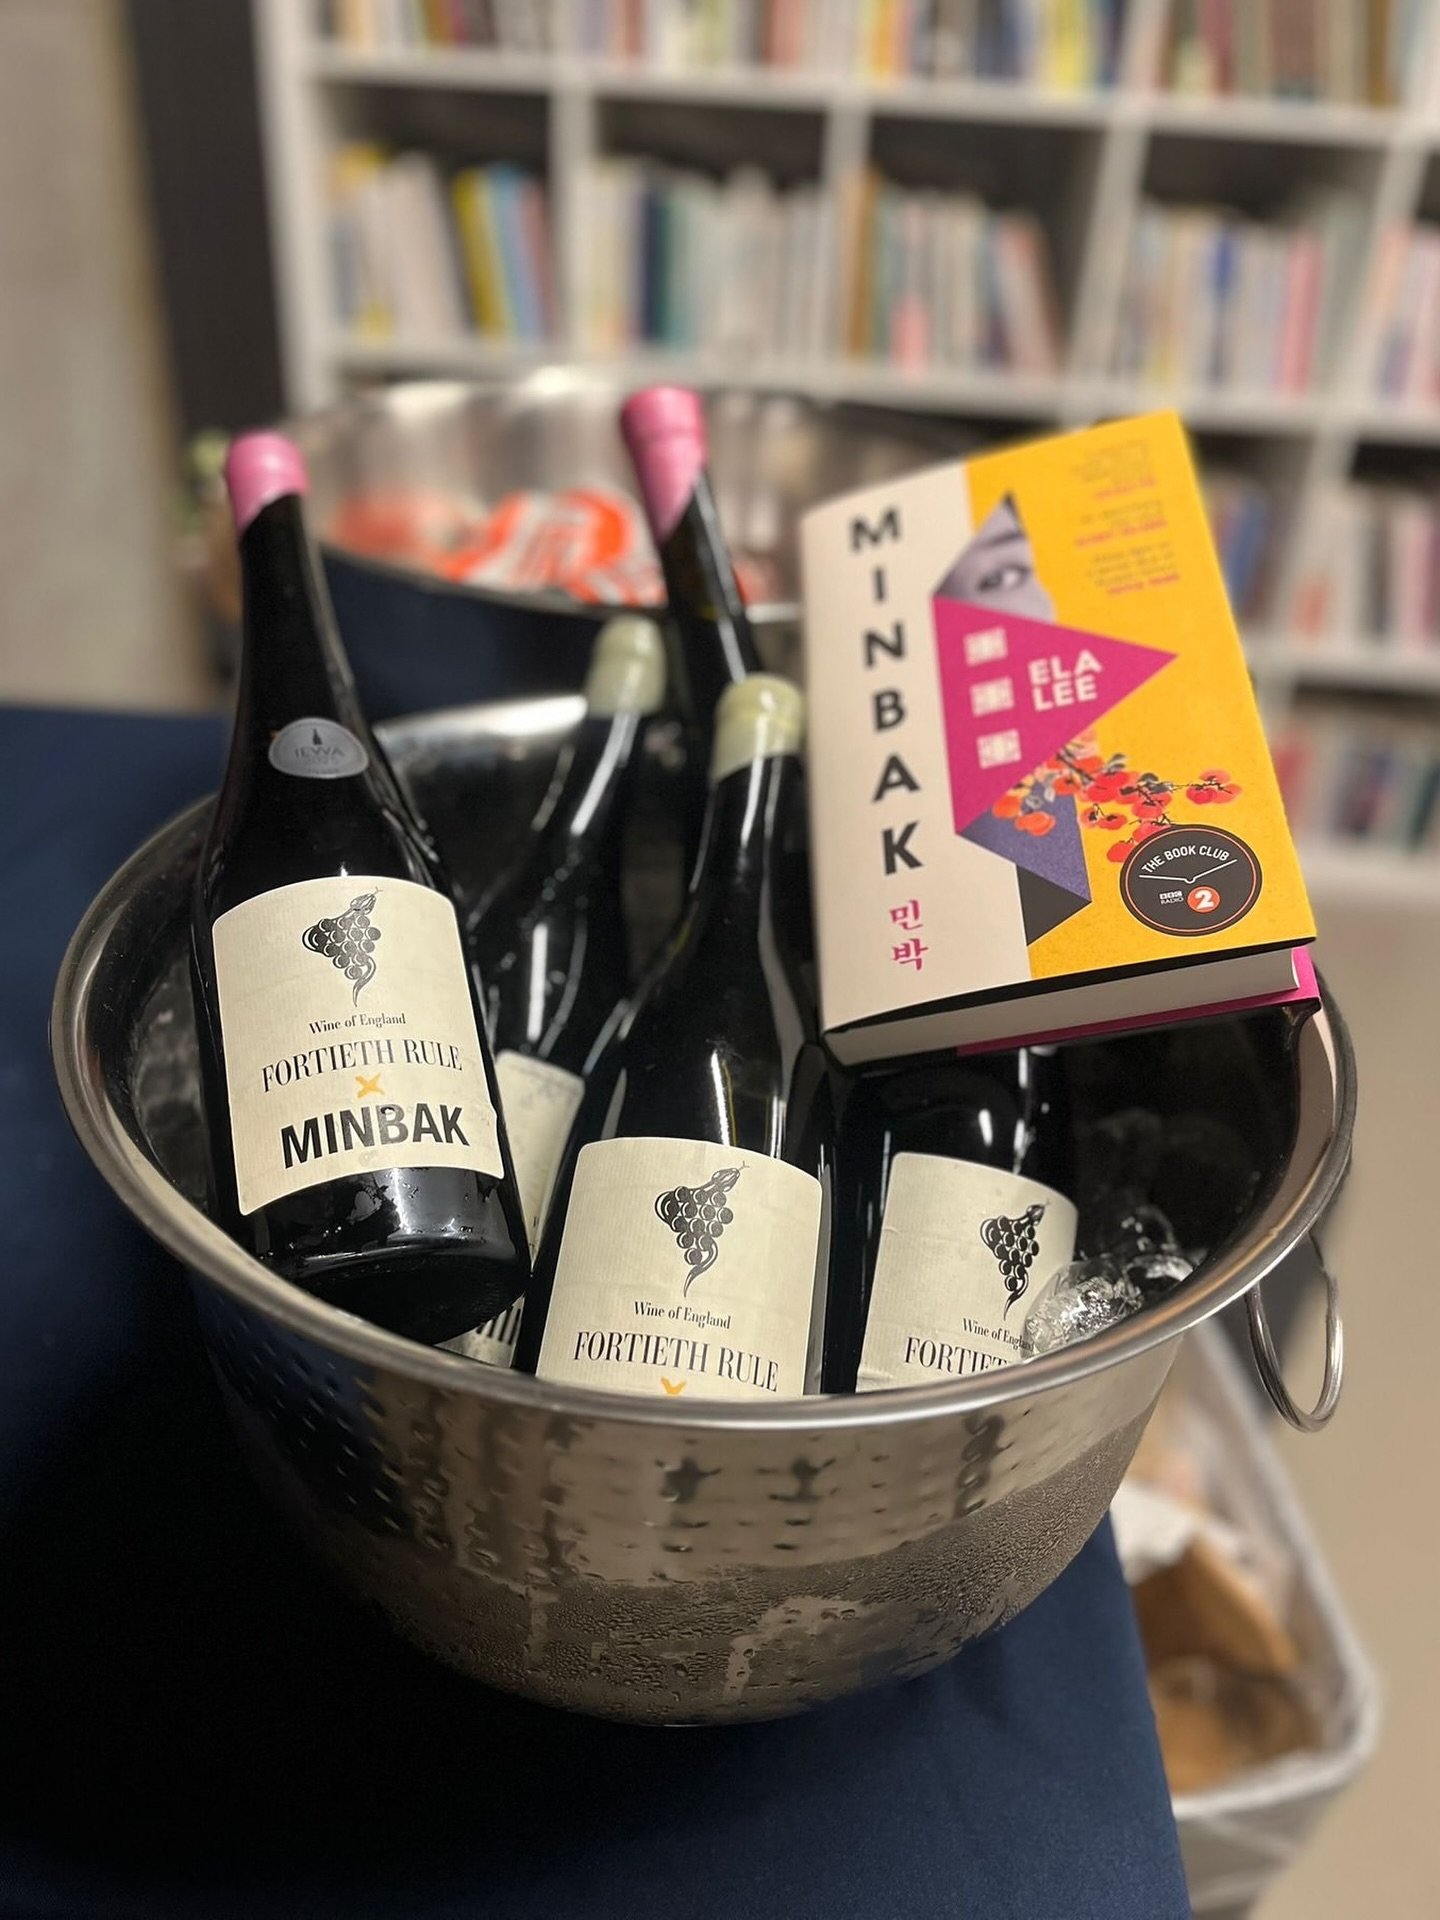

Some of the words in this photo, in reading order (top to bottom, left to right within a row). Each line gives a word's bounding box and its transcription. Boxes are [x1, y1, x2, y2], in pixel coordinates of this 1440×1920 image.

[1028, 650, 1102, 685] ELA
[851, 506, 924, 875] MINBAK
[1033, 674, 1097, 712] LEE
[1141, 856, 1165, 873] THE
[1164, 845, 1196, 861] BOOK
[1199, 845, 1230, 862] CLUB
[1194, 889, 1214, 910] 2
[309, 1019, 341, 1034] Wine
[344, 1014, 358, 1027] of
[359, 1013, 406, 1028] England
[262, 1039, 395, 1093] FORTIETH
[403, 1039, 463, 1071] RULE
[280, 1103, 470, 1169] MINBAK
[634, 1301, 665, 1317] Wine
[667, 1306, 682, 1320] of
[684, 1307, 732, 1329] England
[963, 1318, 990, 1337] Wine
[991, 1328, 1004, 1341] of
[574, 1331, 711, 1373] FORTIETH
[717, 1347, 779, 1392] RULE
